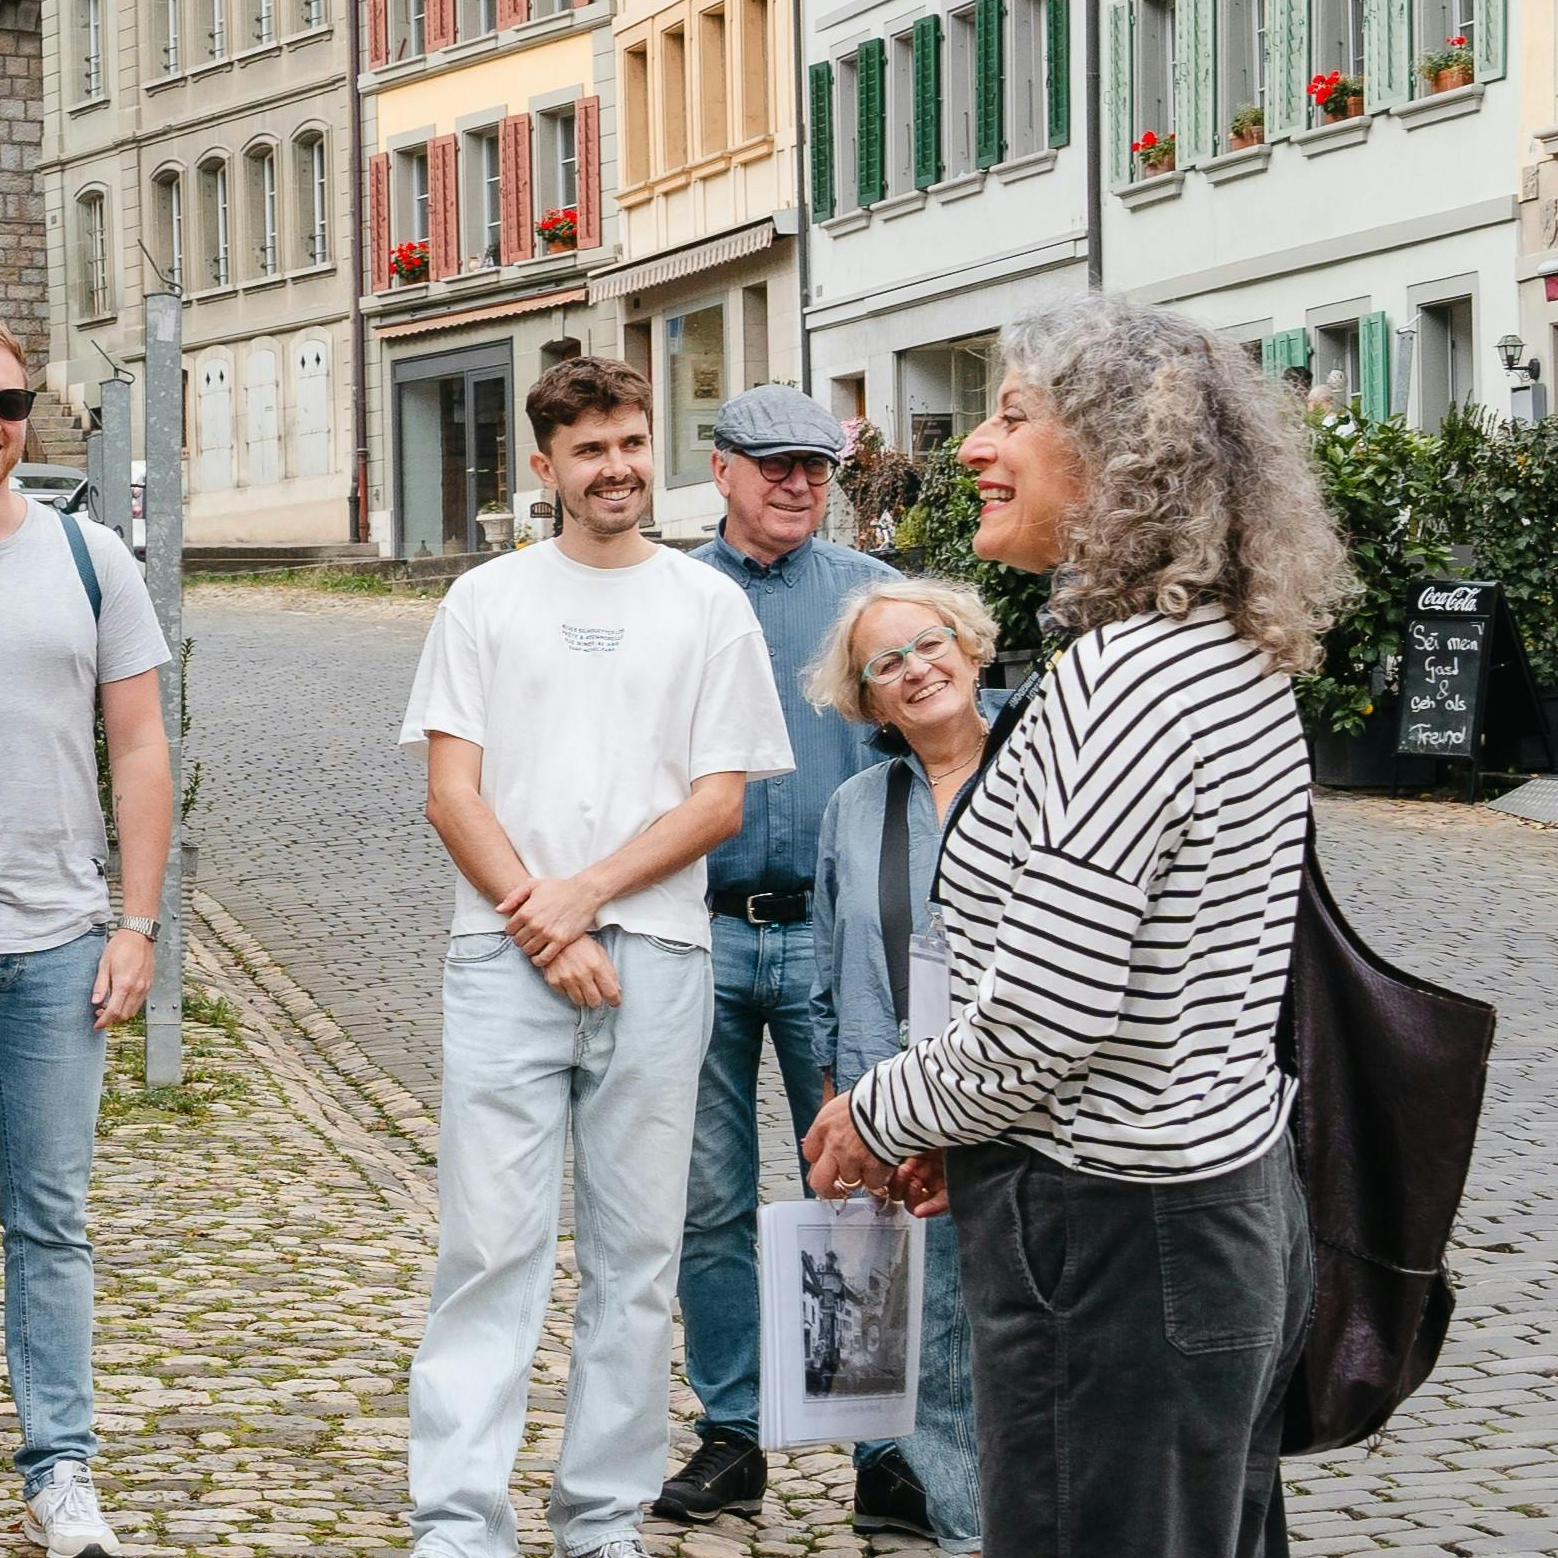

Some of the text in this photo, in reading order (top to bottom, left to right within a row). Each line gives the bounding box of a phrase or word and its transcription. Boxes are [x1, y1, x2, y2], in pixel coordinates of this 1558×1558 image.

[1413, 624, 1478, 651] Sei mein
[1445, 694, 1467, 711] als
